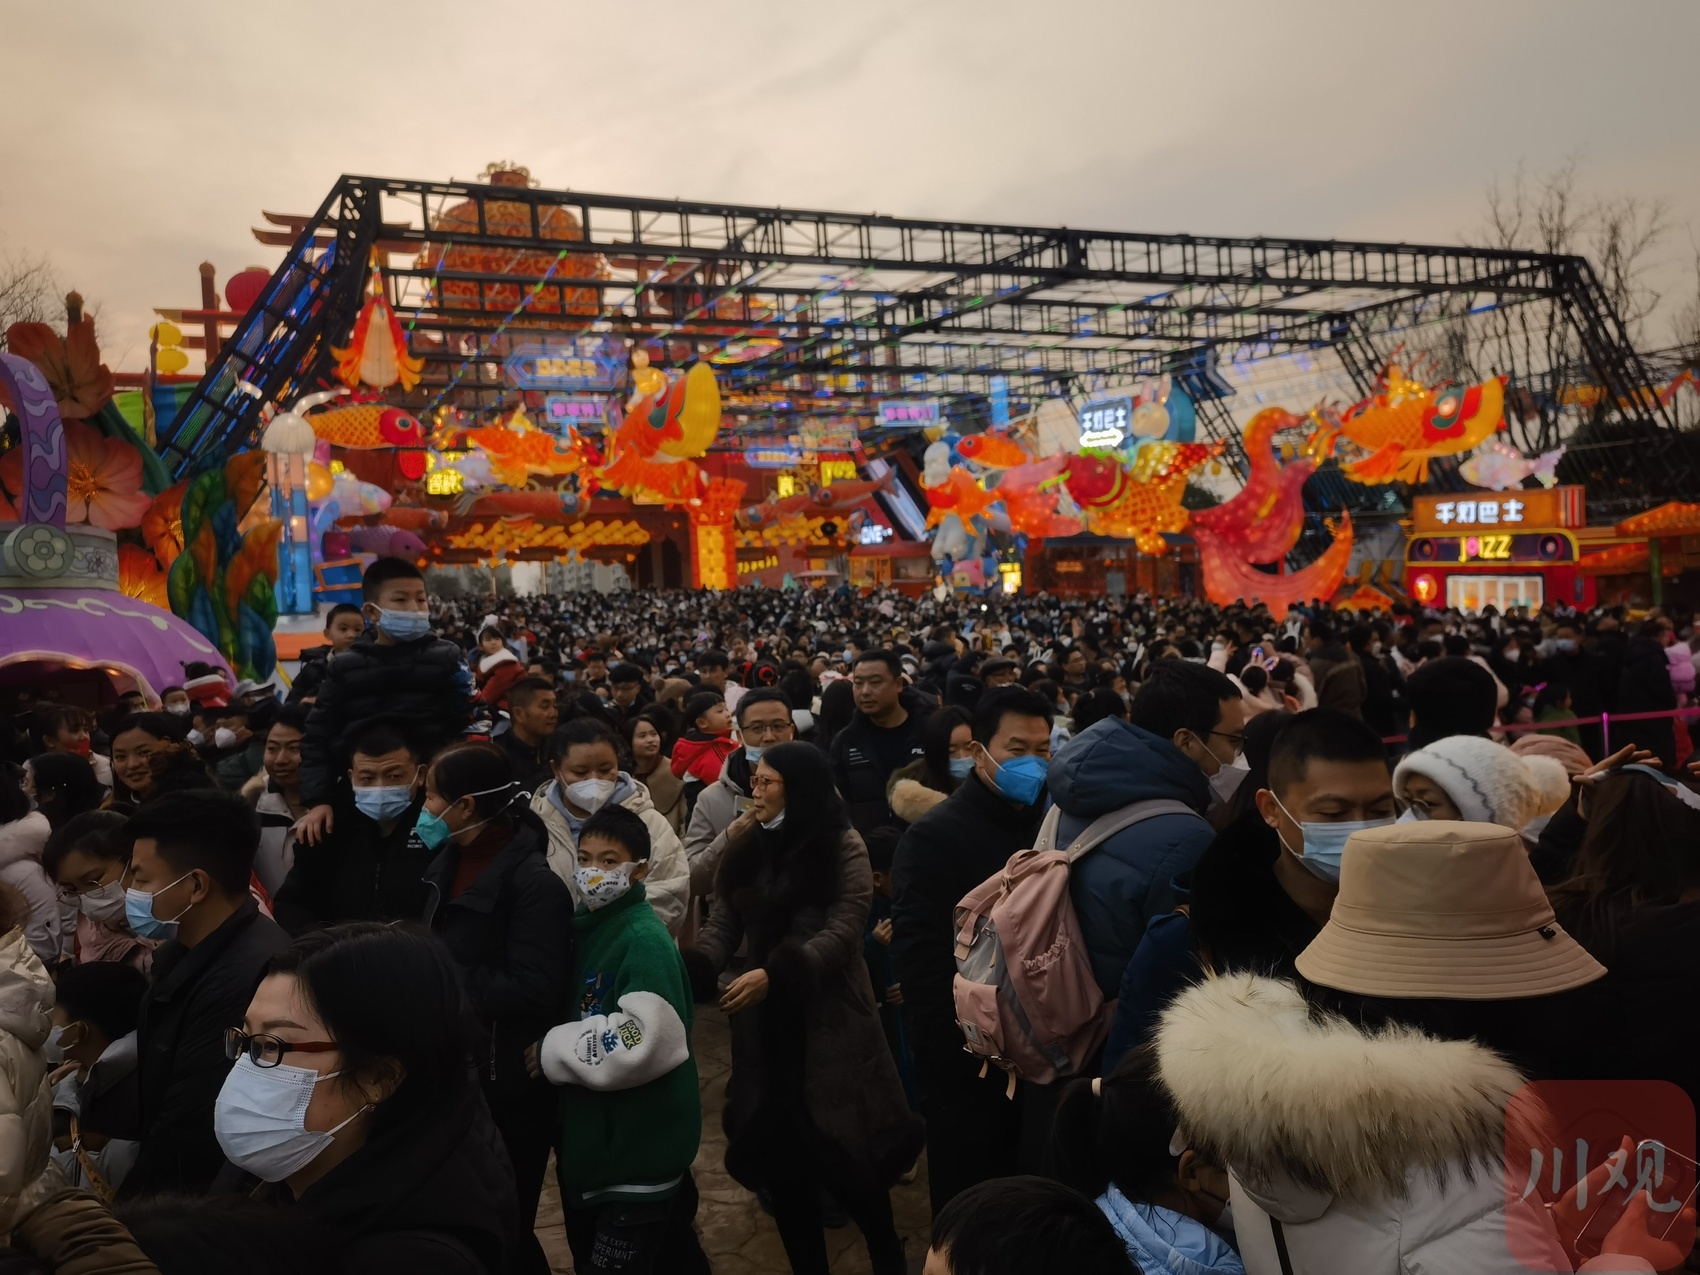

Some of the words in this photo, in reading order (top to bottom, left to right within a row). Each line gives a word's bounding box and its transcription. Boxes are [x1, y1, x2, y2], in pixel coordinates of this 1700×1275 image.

[1435, 499, 1524, 524] 千灯巴士
[911, 747, 926, 755] FIL
[625, 1021, 643, 1045] GOOD
